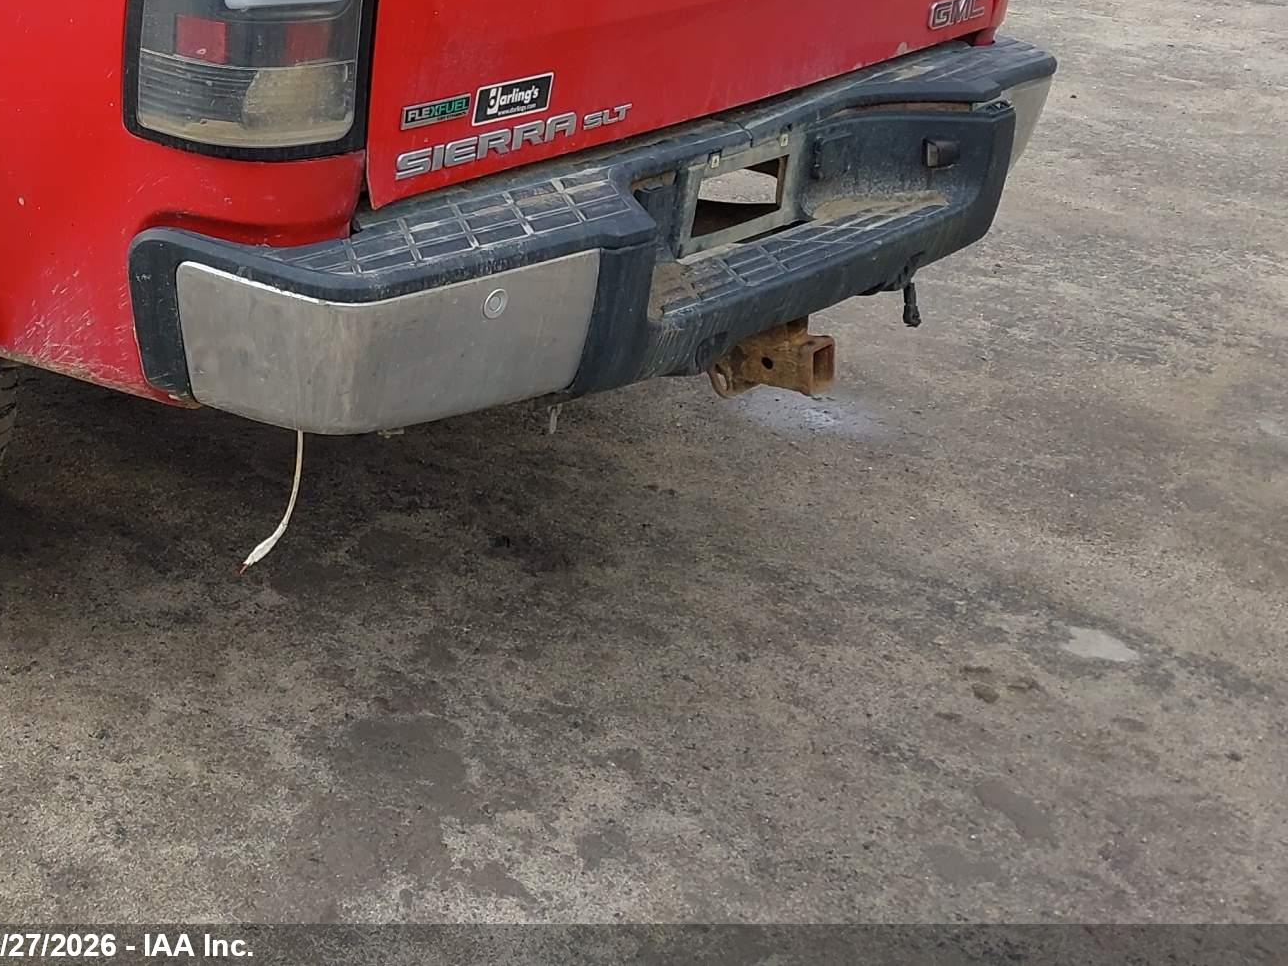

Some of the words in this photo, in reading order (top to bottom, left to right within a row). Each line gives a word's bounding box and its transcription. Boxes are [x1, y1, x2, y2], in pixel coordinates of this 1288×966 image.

[407, 98, 469, 122] FLEXFUEL
[395, 112, 578, 181] SIERRA
[583, 103, 634, 131] SLT
